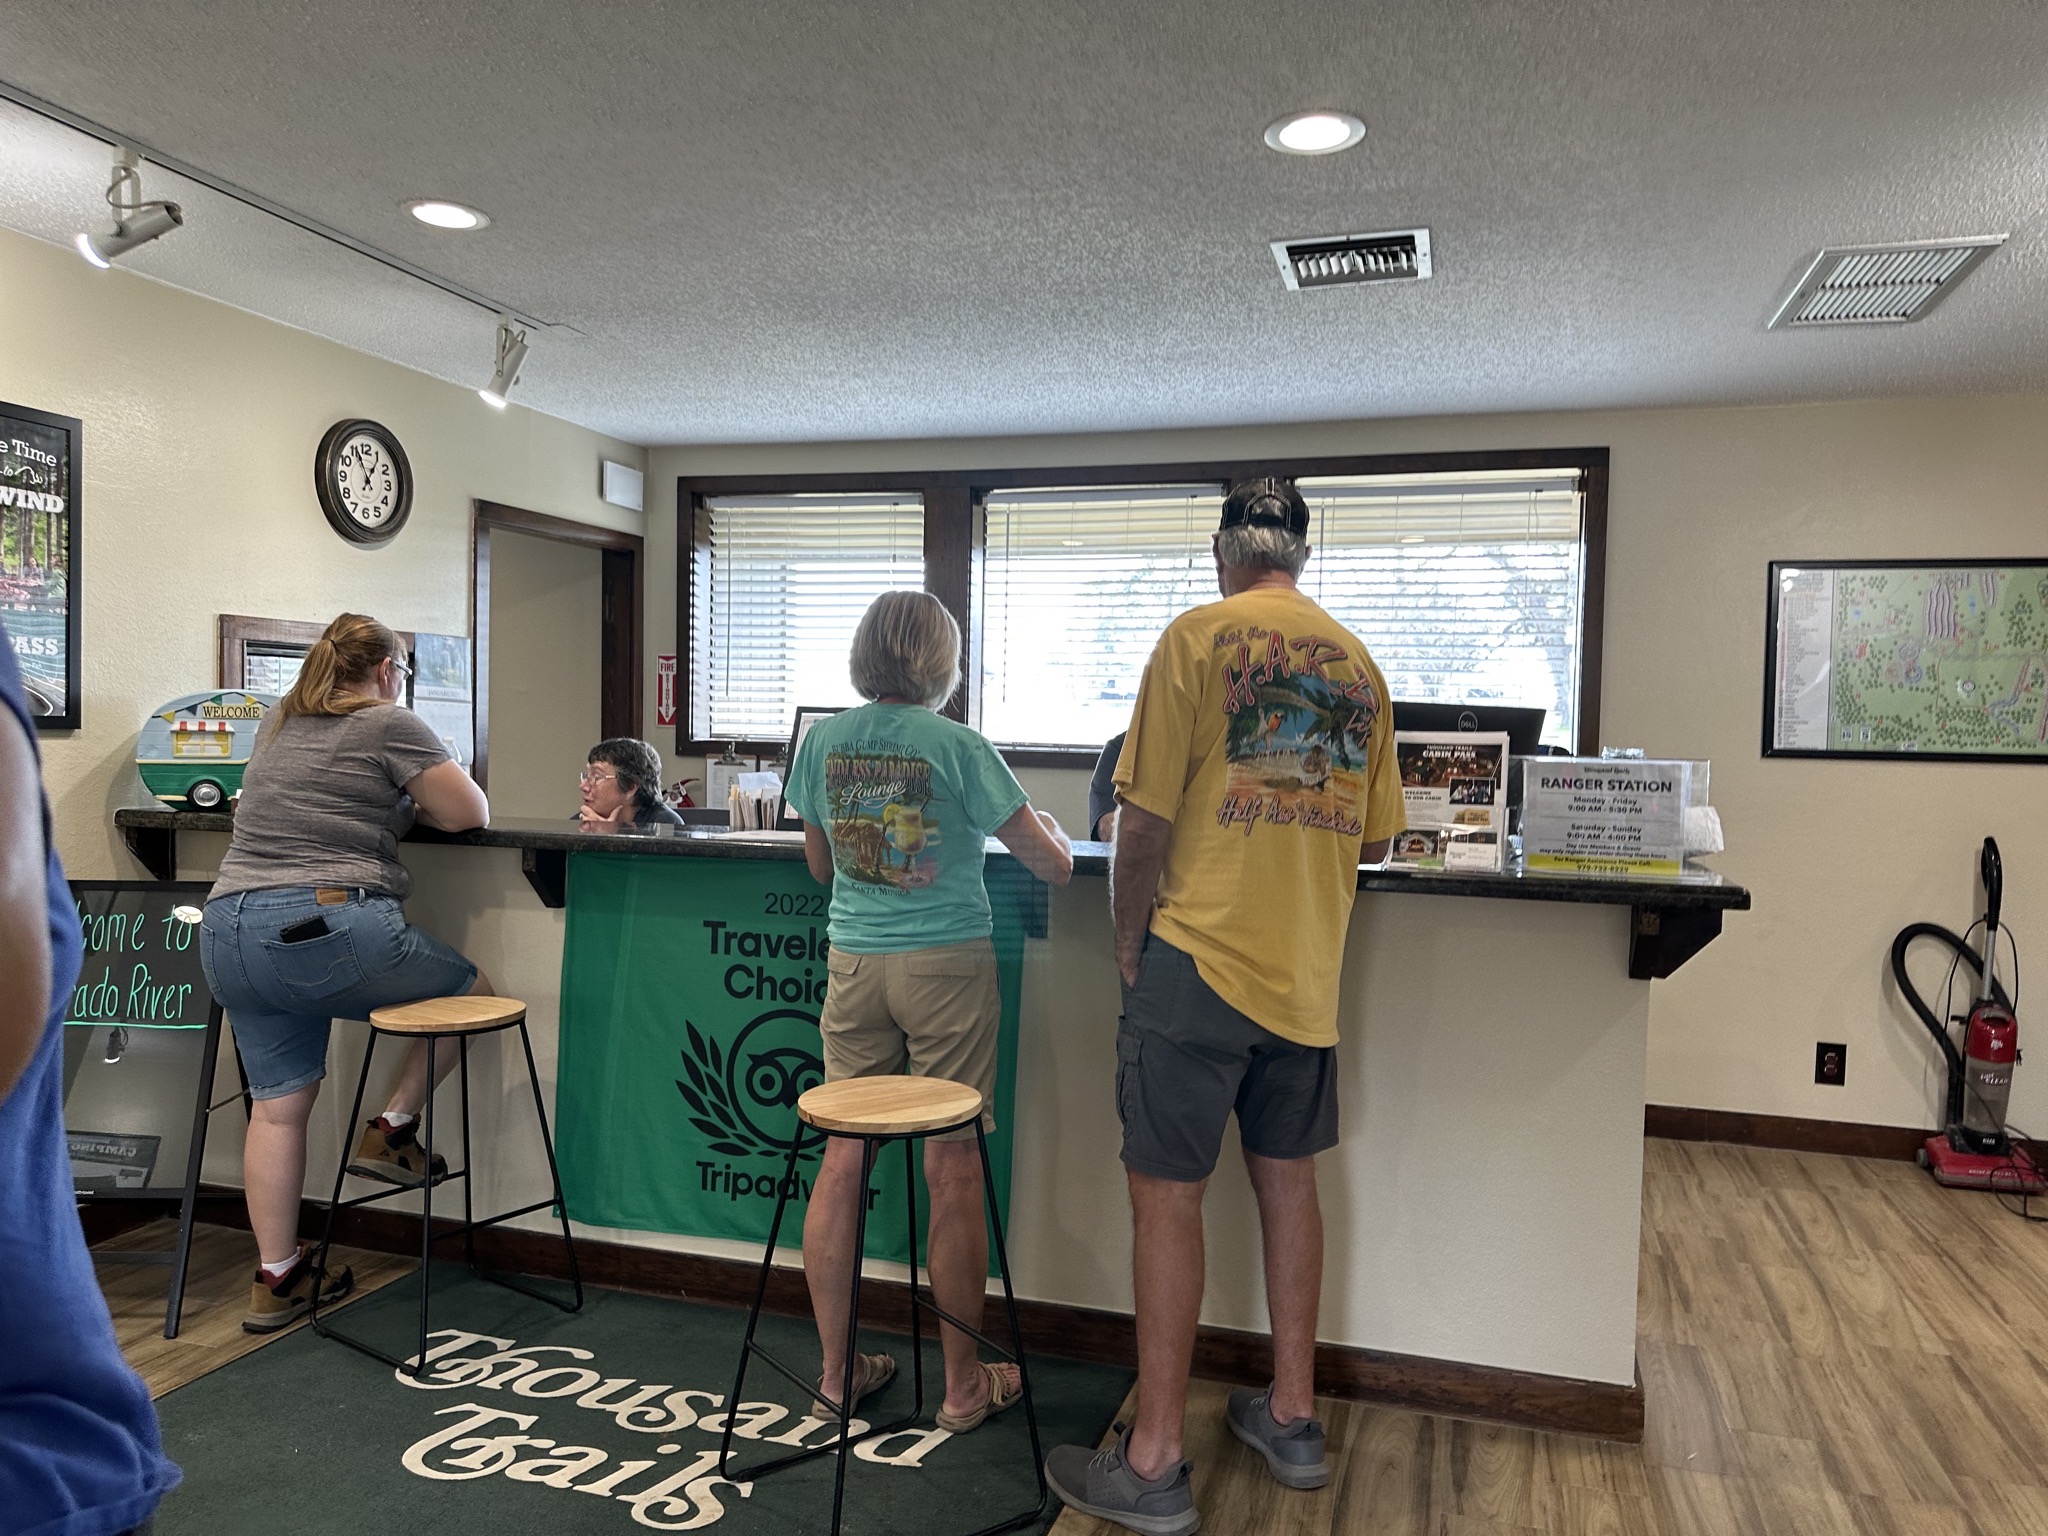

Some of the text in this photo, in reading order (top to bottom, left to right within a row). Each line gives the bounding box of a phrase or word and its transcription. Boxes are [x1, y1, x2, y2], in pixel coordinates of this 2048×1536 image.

[12, 438, 57, 467] Time
[360, 443, 373, 456] 12
[341, 455, 352, 467] 10
[3, 465, 14, 477] to
[339, 470, 347, 482] 9
[382, 464, 390, 476] 2
[384, 480, 392, 491] 3
[342, 488, 351, 499] 8
[381, 496, 389, 506] 4
[350, 502, 358, 513] 7
[362, 508, 370, 519] 6
[373, 506, 381, 518] 5
[10, 636, 58, 656] ASS
[660, 663, 675, 672] FIRE
[203, 706, 259, 718] WELCOME
[1460, 720, 1475, 729] DELL
[856, 738, 878, 751] GUMP
[1422, 750, 1452, 759] CABIN
[1541, 777, 1672, 792] RANGER STATION
[840, 781, 906, 806] Lounge
[1574, 796, 1605, 805] Monday
[1613, 797, 1637, 806] Friday
[1568, 804, 1586, 812] 9:00
[1216, 794, 1262, 836] Half
[1265, 795, 1297, 825] Ass
[1571, 823, 1605, 833] Saturday
[1612, 825, 1641, 834] Sunday
[764, 893, 824, 917] 2022
[78, 902, 192, 952] come to
[73, 963, 192, 1020] ado River
[395, 1329, 955, 1467] Thousand
[401, 1402, 754, 1531] Trails
